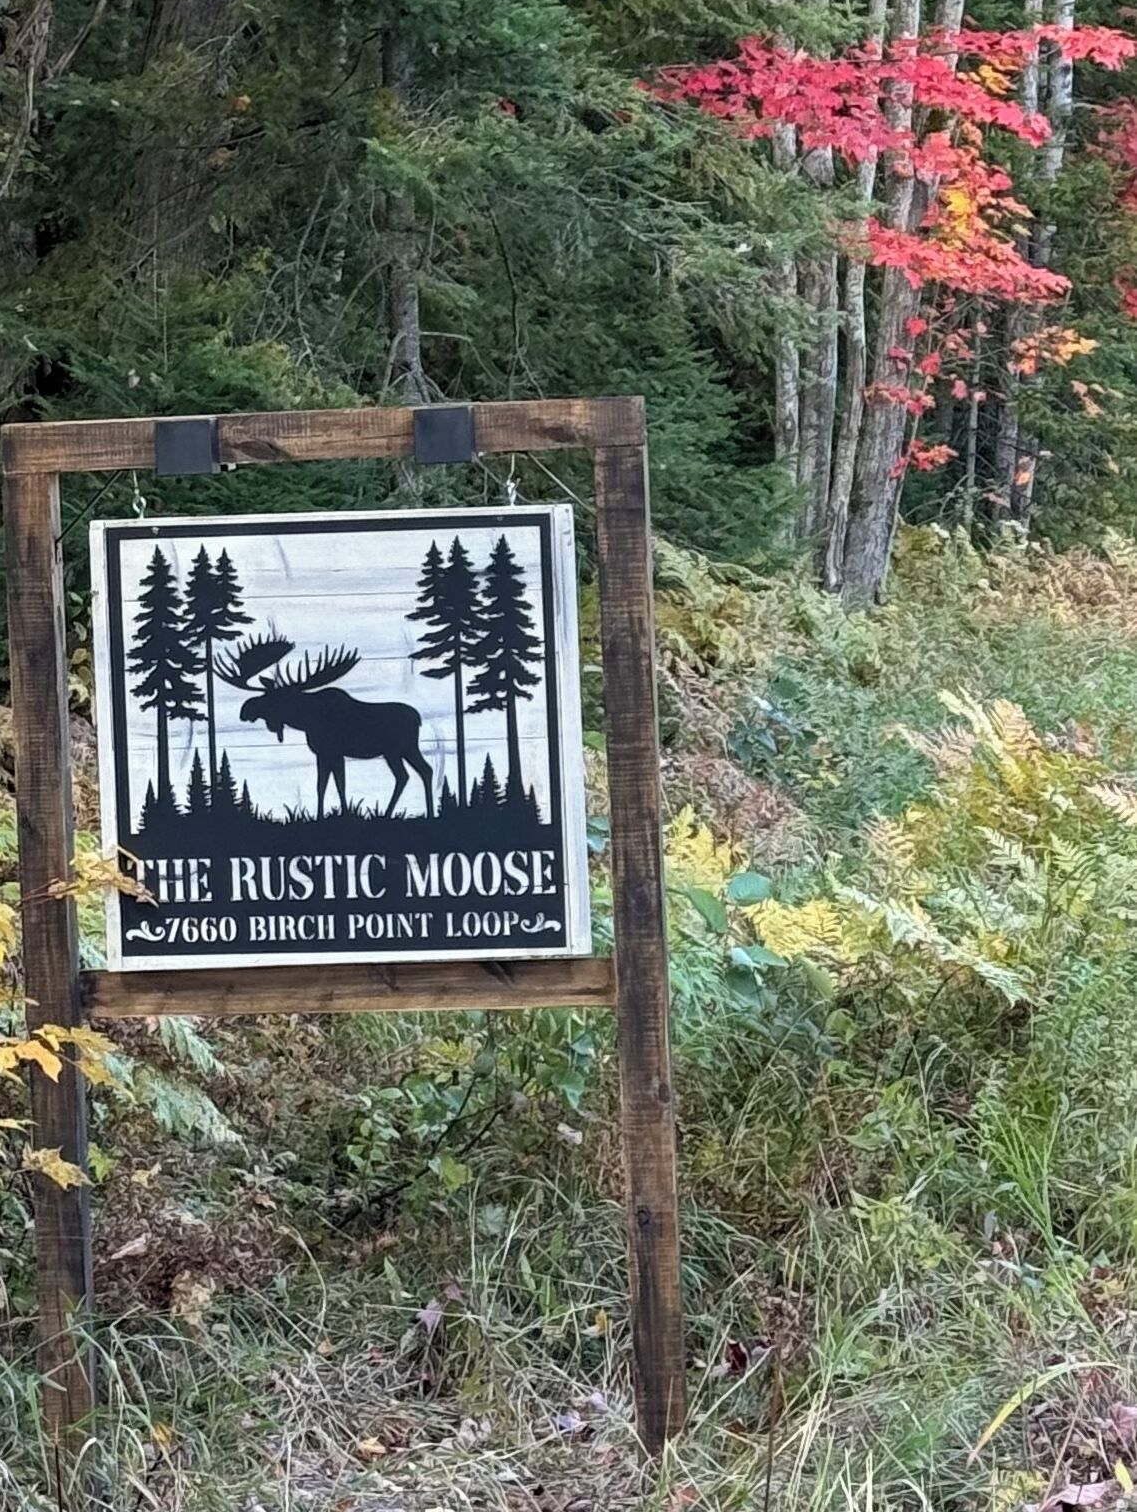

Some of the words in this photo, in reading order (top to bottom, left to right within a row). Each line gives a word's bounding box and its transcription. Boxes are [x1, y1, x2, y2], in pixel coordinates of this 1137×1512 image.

[126, 857, 213, 903] THE
[230, 854, 388, 902] RUSTIC
[404, 850, 557, 899] MOOSE
[164, 916, 237, 944] 7660
[249, 914, 336, 941] BIRCH
[348, 912, 433, 939] POINT
[445, 910, 520, 938] LOOP
